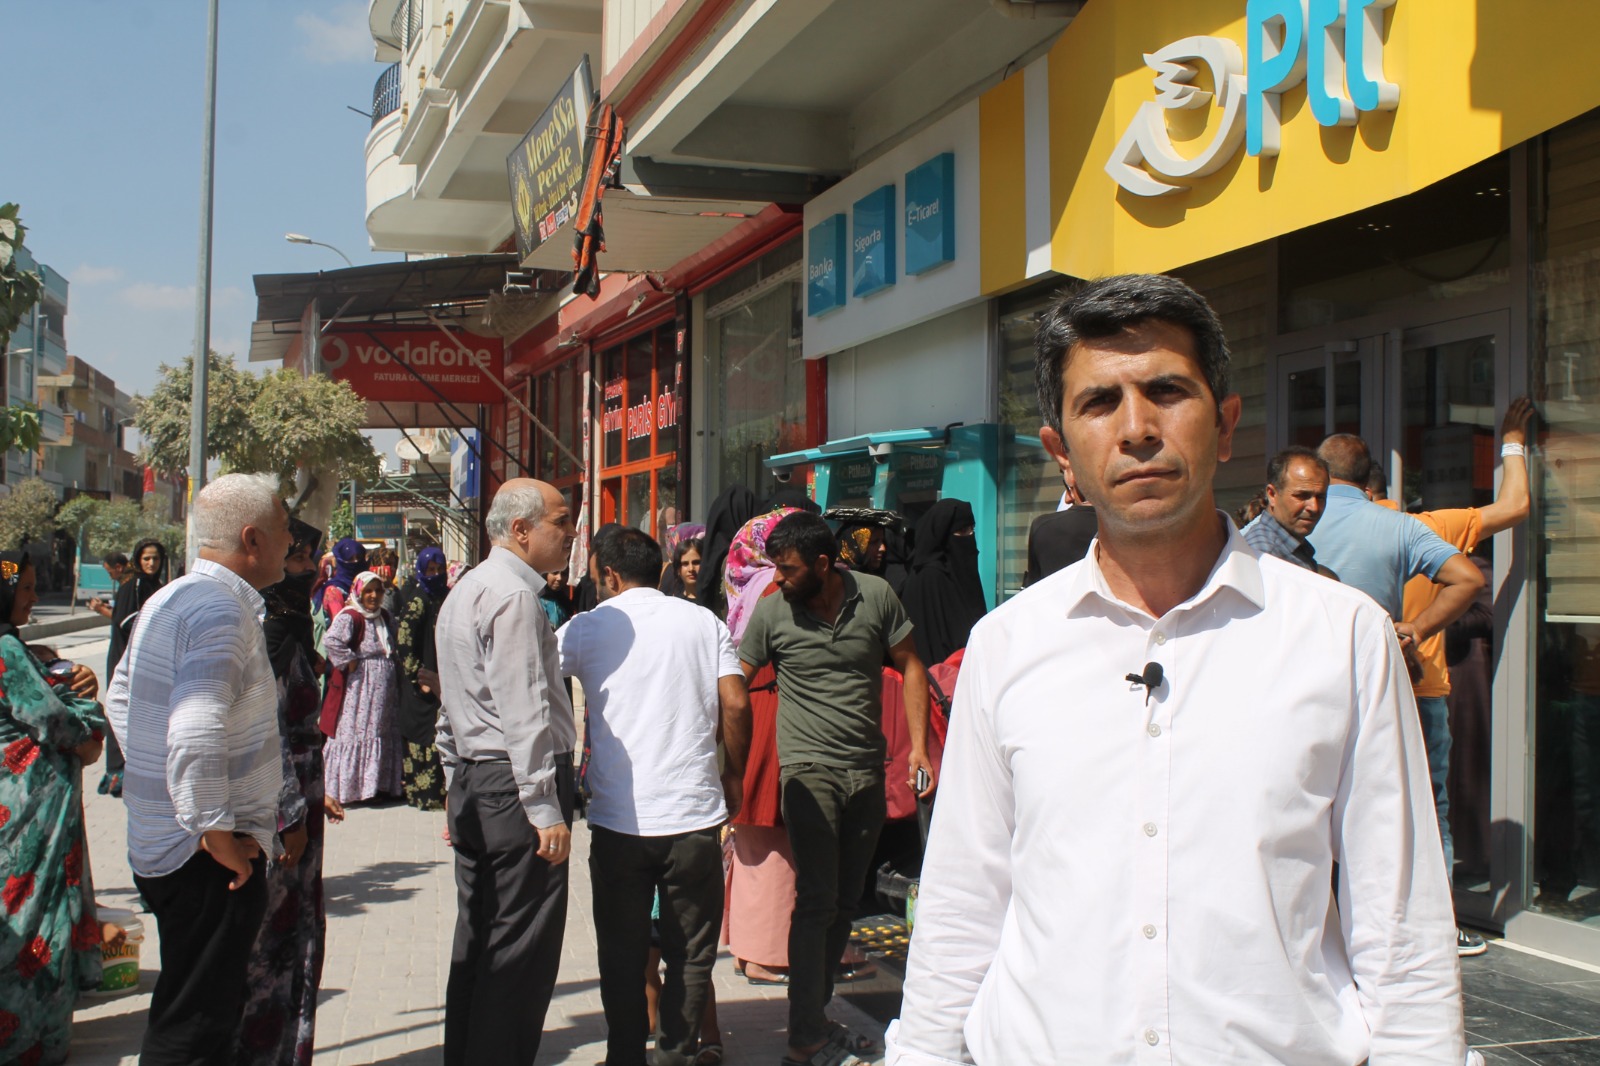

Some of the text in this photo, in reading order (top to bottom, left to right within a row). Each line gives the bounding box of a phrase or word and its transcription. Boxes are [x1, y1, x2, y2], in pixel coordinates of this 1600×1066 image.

[908, 198, 940, 226] E-Ticaret
[855, 229, 881, 253] Sigorta
[809, 257, 833, 280] Banka
[355, 340, 492, 367] vodafone
[373, 373, 407, 382] FATURA
[627, 394, 653, 440] PARİS
